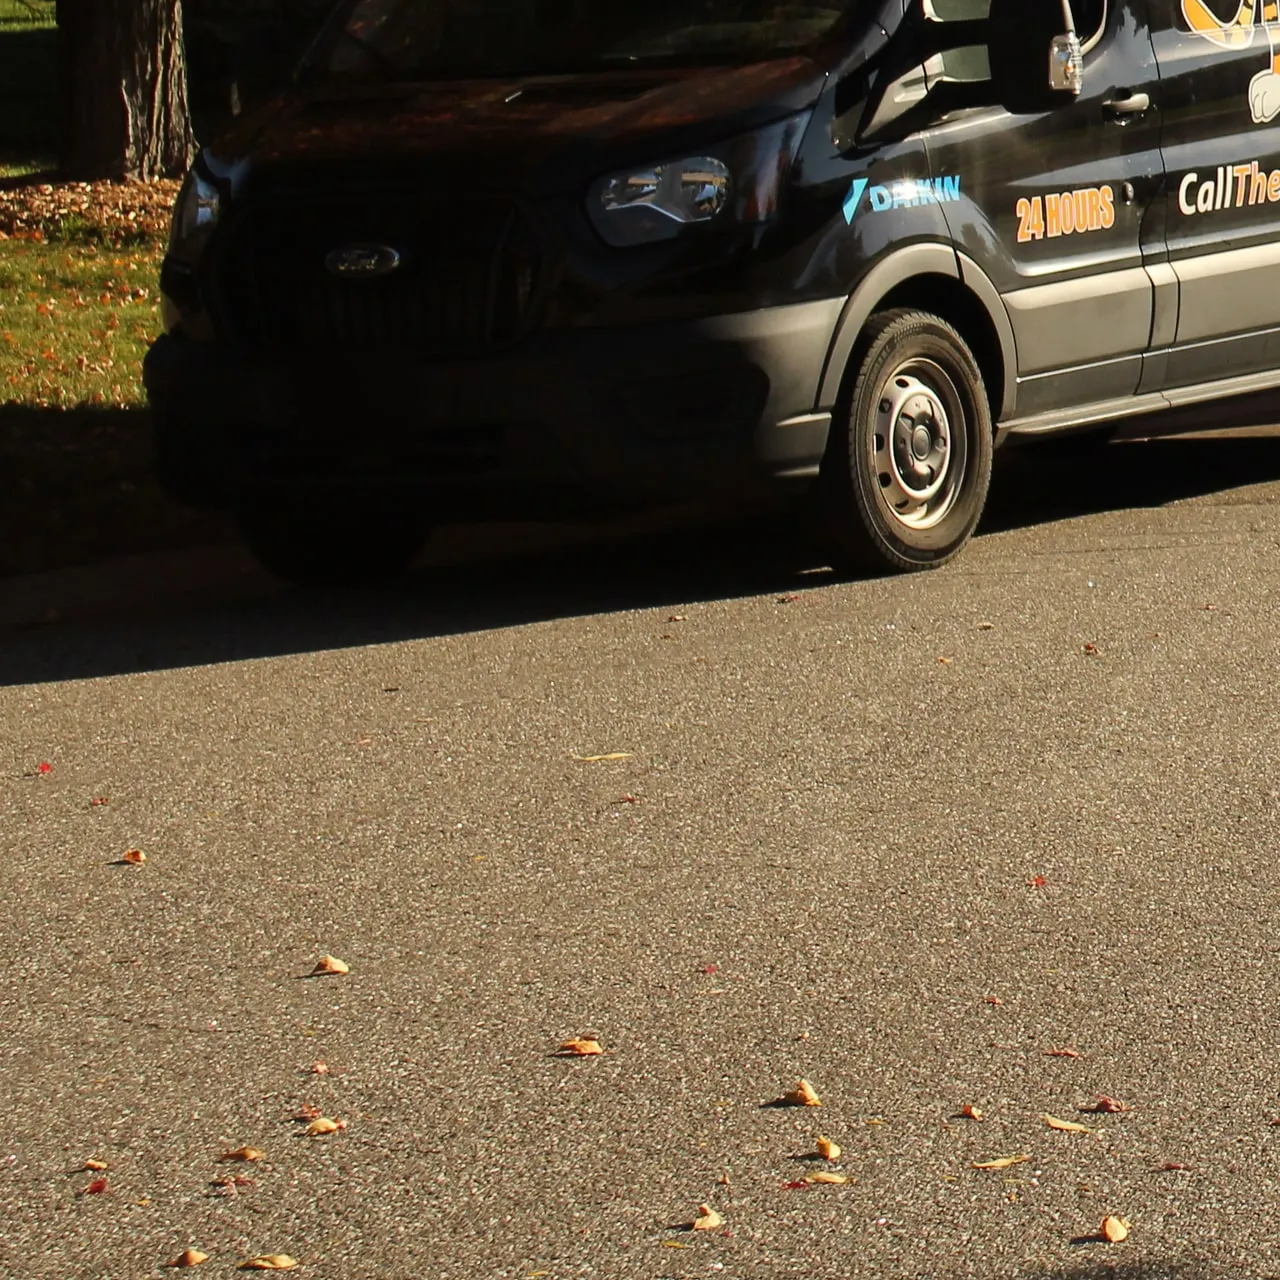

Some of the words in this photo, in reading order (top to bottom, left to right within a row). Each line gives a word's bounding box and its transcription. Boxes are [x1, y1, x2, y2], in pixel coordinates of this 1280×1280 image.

[869, 175, 960, 212] DAIKIN
[1016, 197, 1045, 243] 24
[1046, 185, 1115, 237] HOURS
